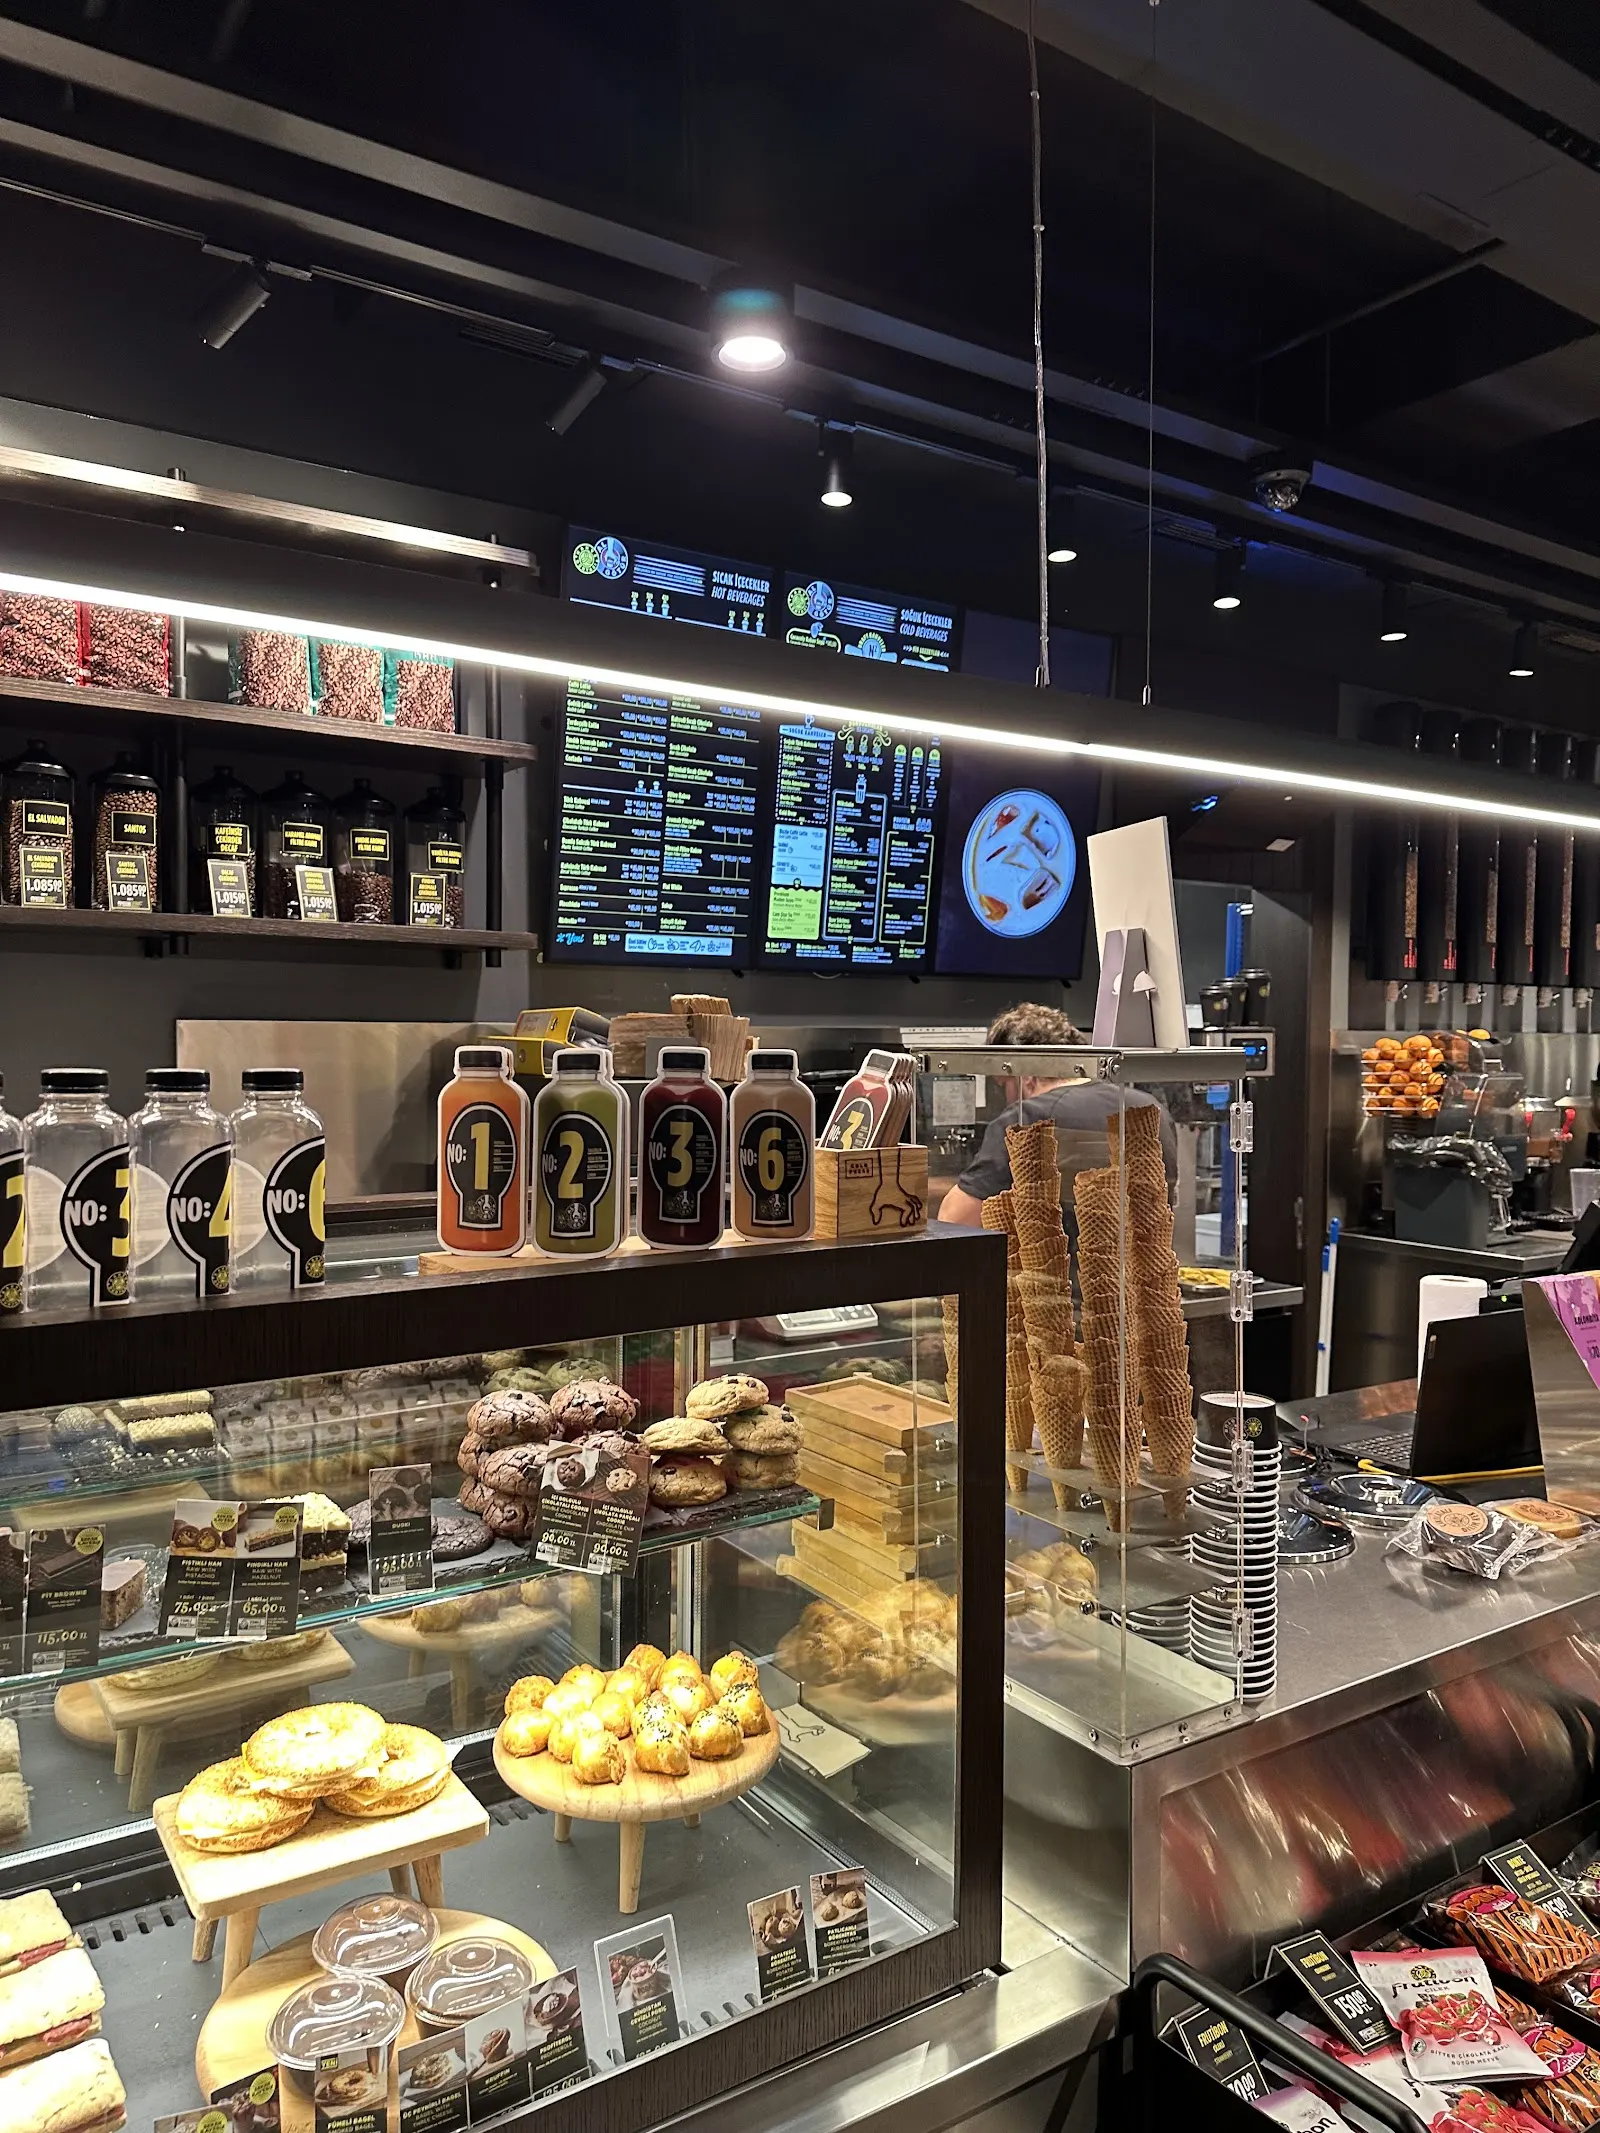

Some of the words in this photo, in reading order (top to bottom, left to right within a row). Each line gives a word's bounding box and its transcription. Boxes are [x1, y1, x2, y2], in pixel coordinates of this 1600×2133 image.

[712, 569, 733, 587] SICAK
[735, 573, 770, 594] İÇECEKLER
[711, 586, 725, 600] HOT
[727, 588, 766, 608] BEVERAGES
[900, 623, 914, 637] COLD
[915, 625, 949, 643] BEVERAGES
[29, 813, 36, 823] EL
[36, 814, 66, 826] SALVADOR
[124, 824, 147, 834] SANTOS
[447, 1143, 467, 1164] NO:
[470, 1121, 490, 1190] 1
[542, 1153, 558, 1174] NO:
[558, 1130, 584, 1199] 2
[649, 1141, 667, 1160] NO:
[667, 1121, 694, 1187] 3
[740, 1148, 757, 1166] NO:
[758, 1127, 785, 1192] 6
[170, 1196, 211, 1223] NO:
[267, 1188, 305, 1214] NO:
[64, 1200, 107, 1227] NO:
[243, 1602, 278, 1616] 65,00
[37, 1629, 79, 1645] 115,00
[80, 1630, 88, 1639] TL
[1197, 2020, 1229, 2048] FRUTİBON
[1458, 2051, 1491, 2060] ÇİKOLATA
[441, 2091, 462, 2104] BAGEL
[353, 2114, 375, 2125] BAGEL
